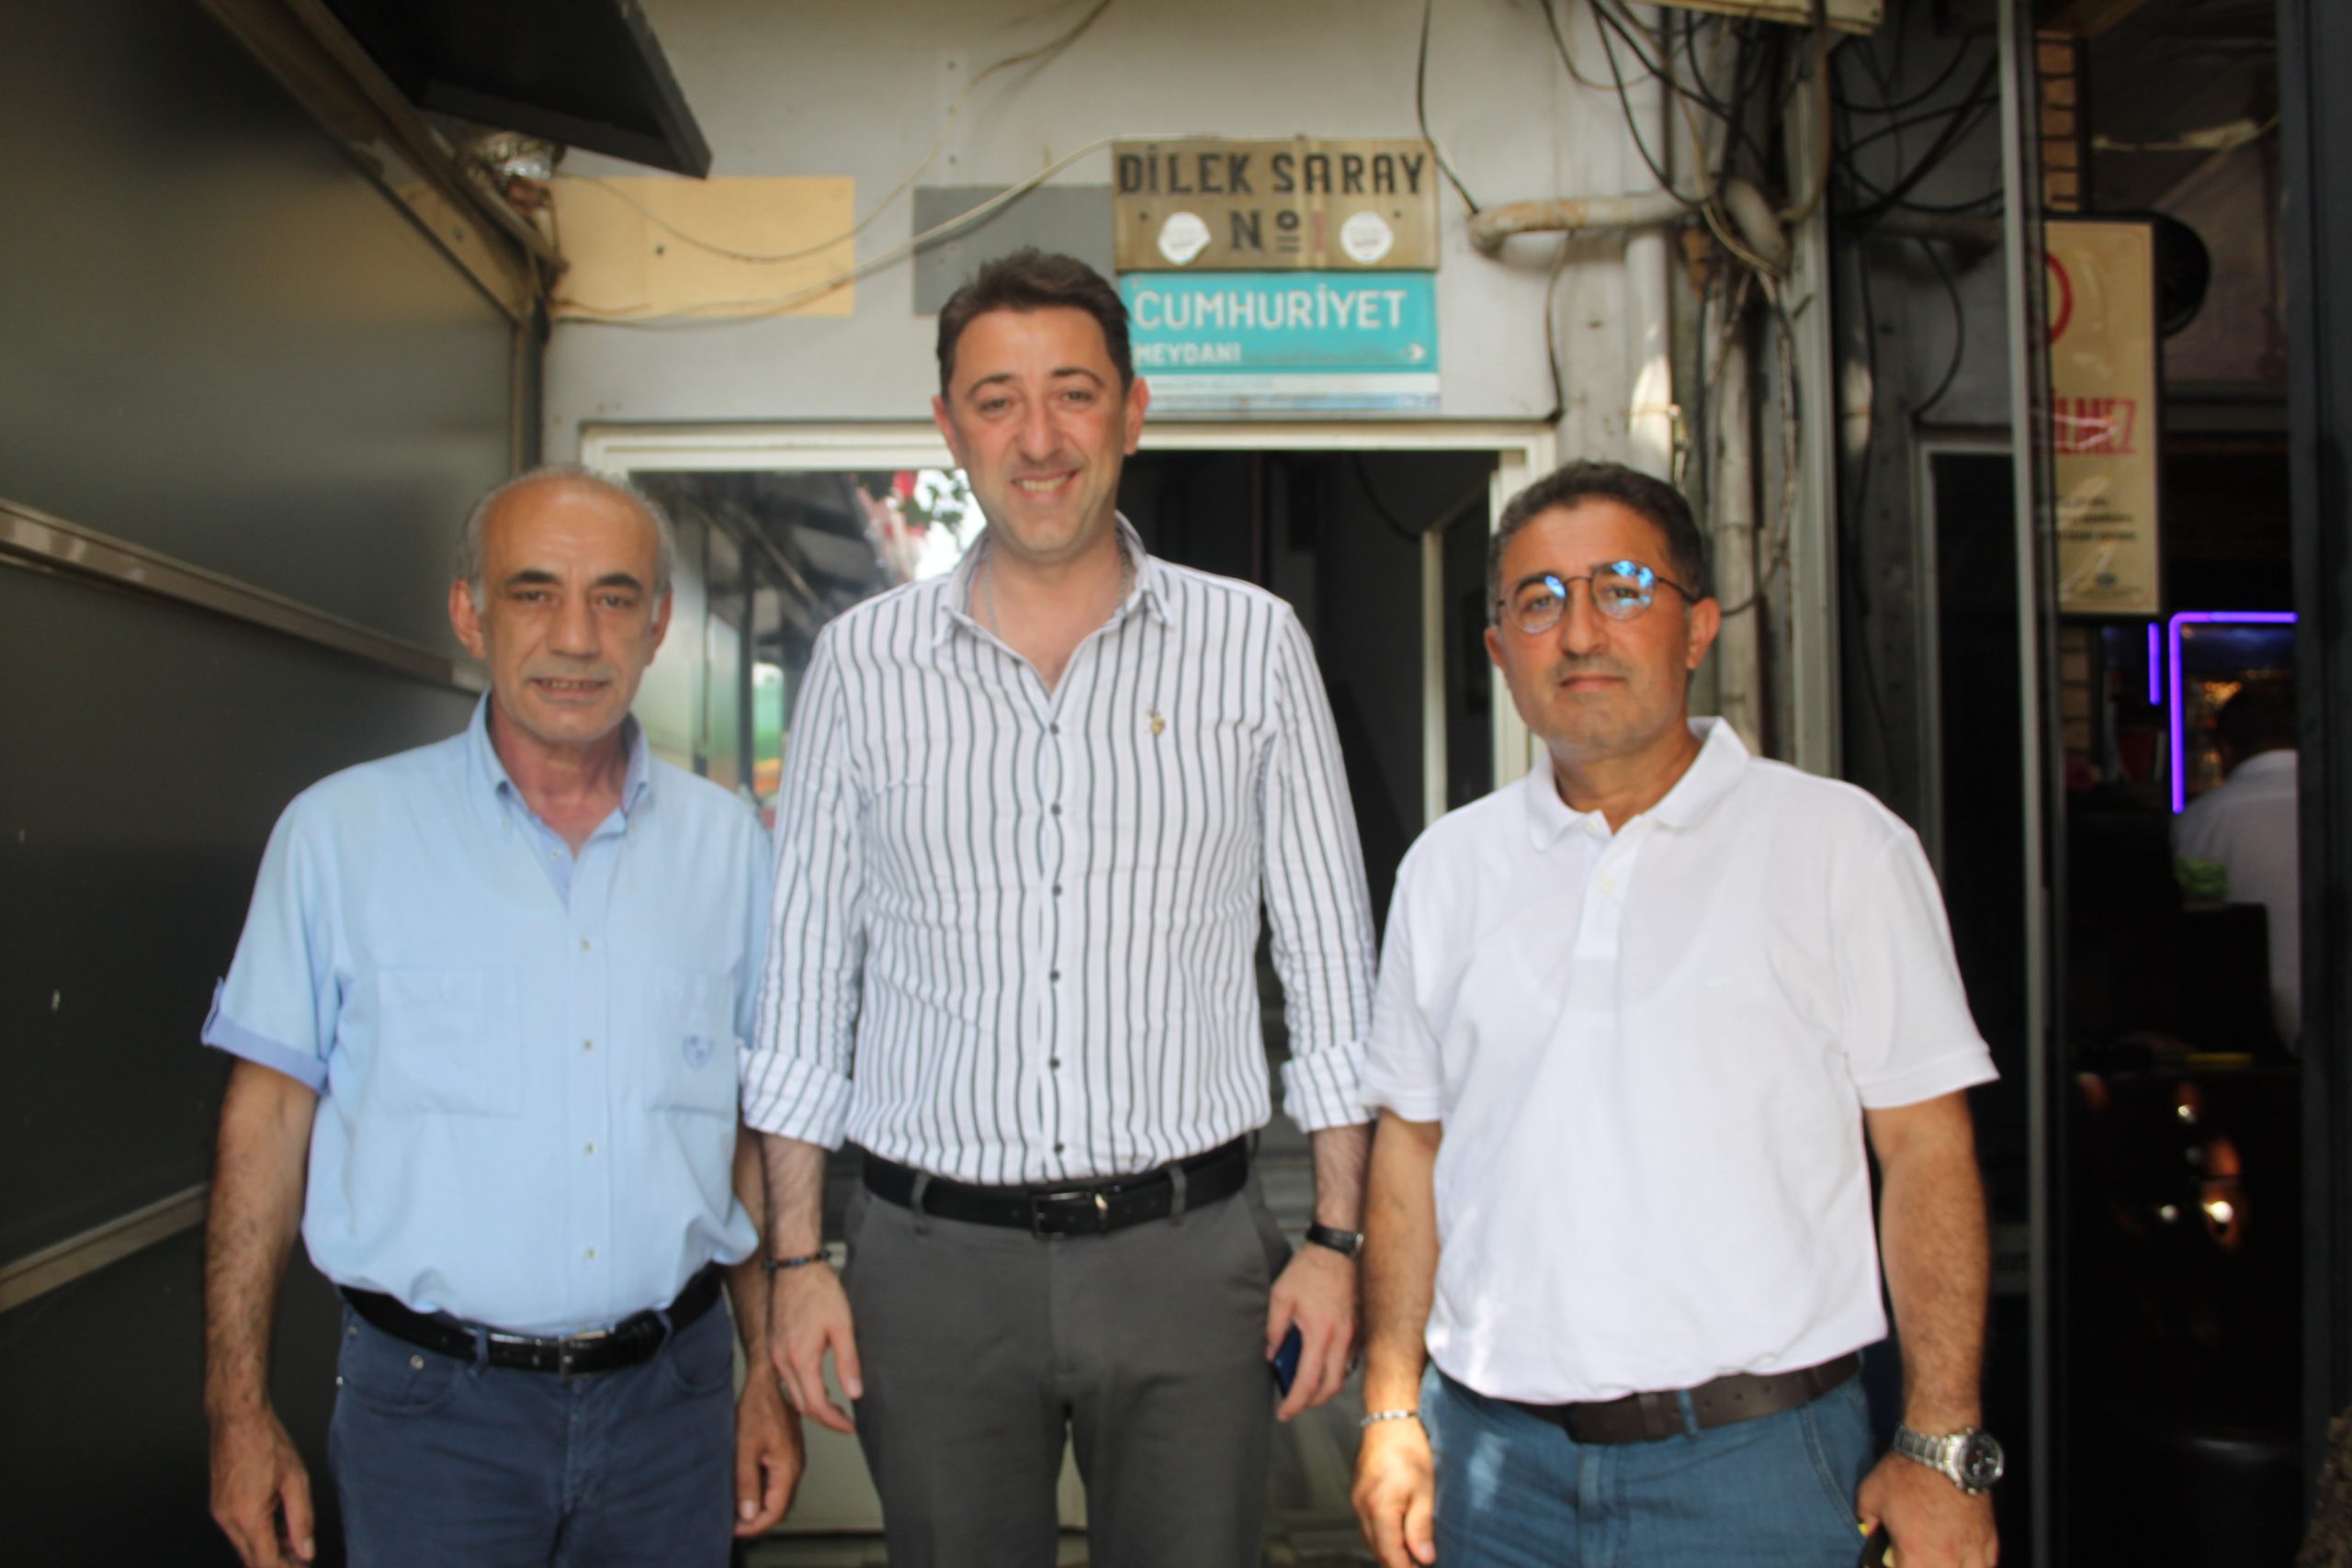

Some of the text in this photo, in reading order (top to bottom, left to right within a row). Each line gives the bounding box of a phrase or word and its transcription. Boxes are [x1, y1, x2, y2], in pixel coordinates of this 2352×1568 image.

[1118, 145, 1425, 195] DİLEK SARAY
[1133, 284, 1408, 330] CUMHURİYET
[1133, 341, 1242, 366] MEYDANI
